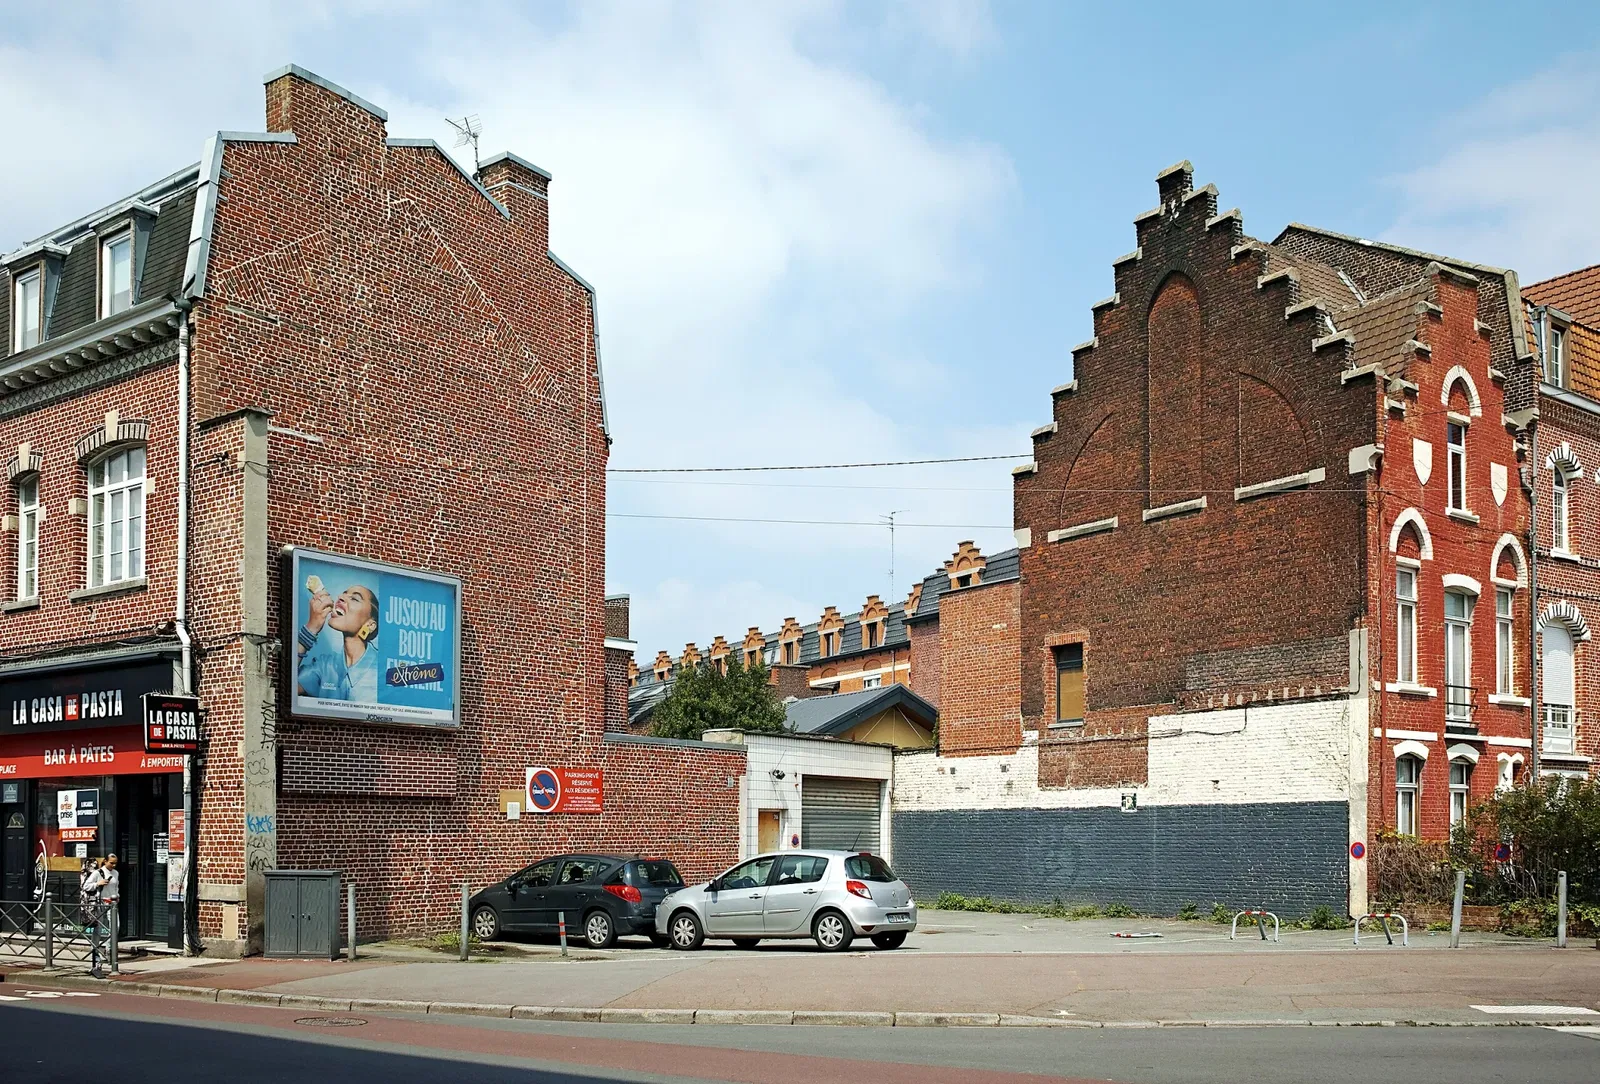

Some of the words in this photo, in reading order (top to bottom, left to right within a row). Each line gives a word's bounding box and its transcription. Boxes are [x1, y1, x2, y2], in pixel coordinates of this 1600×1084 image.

[385, 595, 446, 632] JUSQU'AU
[398, 629, 434, 660] BOUT
[391, 666, 438, 686] extrême
[12, 700, 27, 725] LA
[31, 695, 63, 724] CASA
[67, 698, 77, 716] DE
[81, 689, 123, 719] PASTA
[149, 710, 163, 724] LA
[165, 711, 195, 726] CASA
[153, 727, 162, 737] DE
[166, 725, 197, 740] PASTA
[44, 748, 66, 766] BAR
[69, 744, 77, 764] À
[80, 743, 114, 764] PÂTES
[140, 755, 146, 768] À
[147, 756, 183, 768] EMPORTER
[0, 764, 17, 774] PLACE
[565, 771, 586, 779] PARKING
